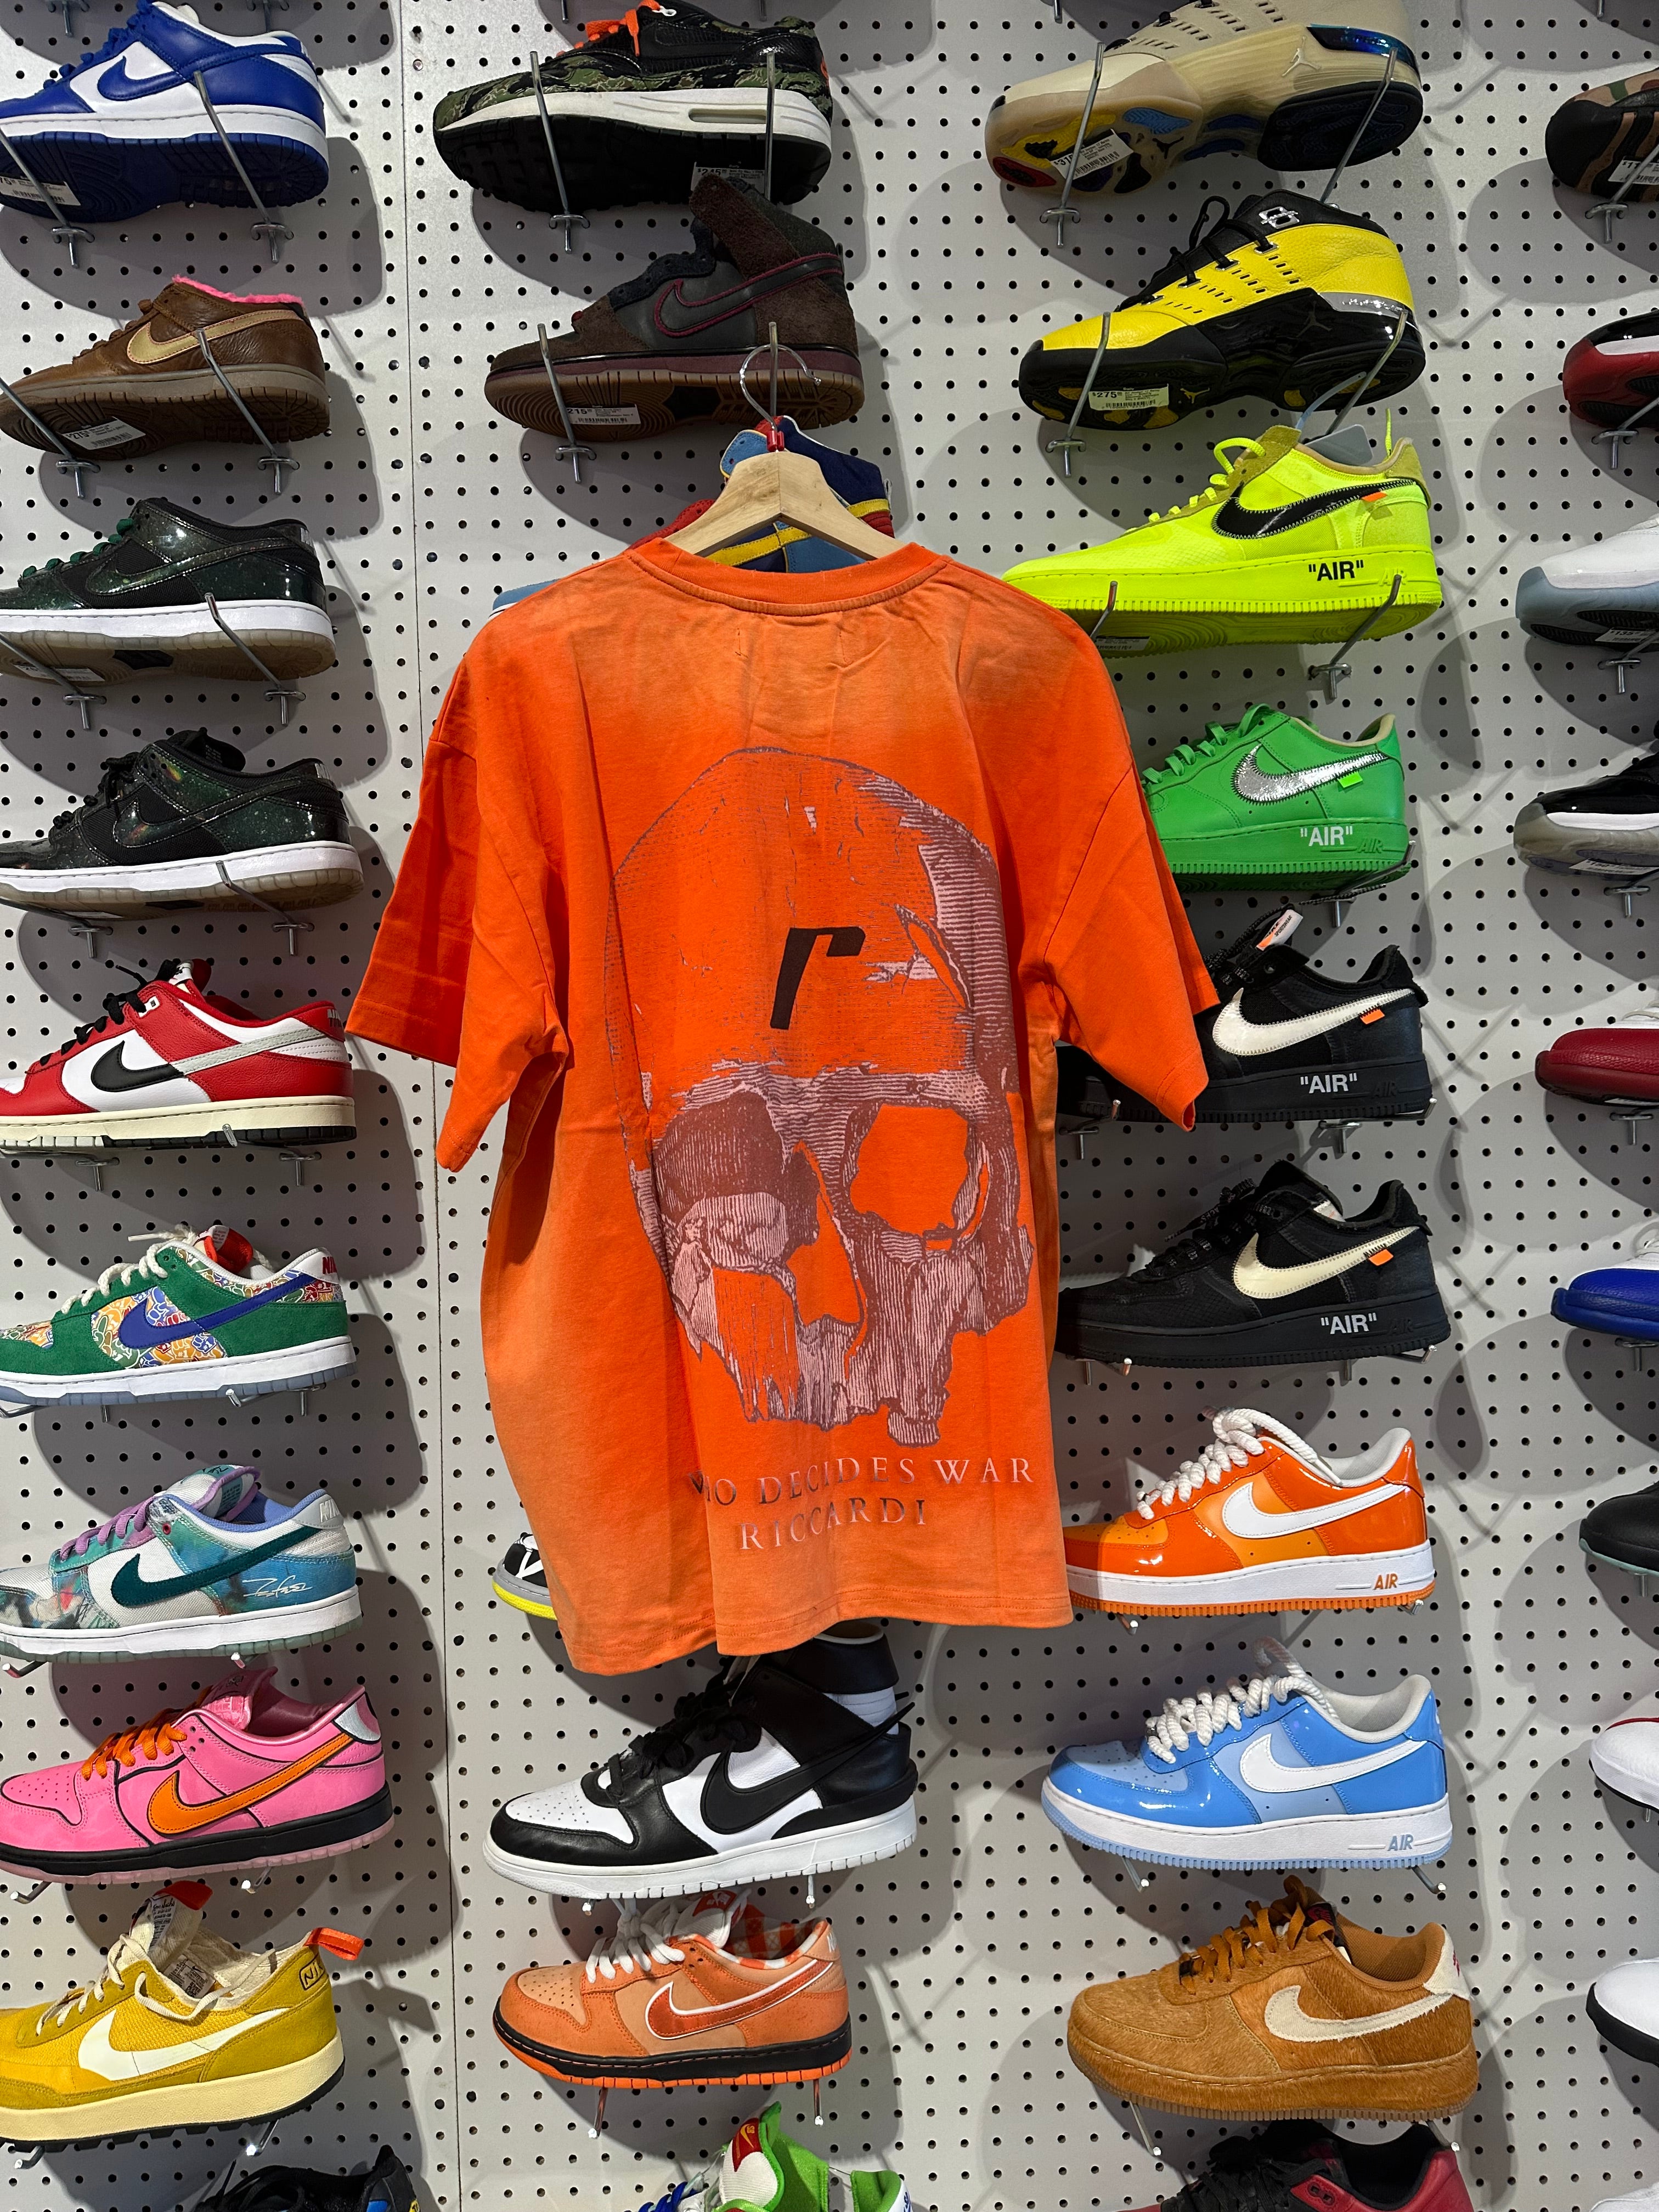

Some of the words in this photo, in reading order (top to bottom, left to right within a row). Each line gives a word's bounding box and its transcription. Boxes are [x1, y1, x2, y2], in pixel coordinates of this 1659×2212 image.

[1308, 560, 1364, 582] "AIR"
[1300, 826, 1353, 847] "AIR"
[1358, 838, 1384, 854] AIR
[1274, 915, 1293, 937] SPORTSWEAR
[1300, 1073, 1358, 1094] "AIR"
[1321, 1312, 1378, 1335] "AIR"
[757, 1457, 915, 1505] DECIDES
[934, 1458, 1034, 1485] WAR
[741, 1497, 926, 1550] RICCARDI
[1373, 1573, 1398, 1590] AIR
[1387, 1834, 1414, 1852] AIR
